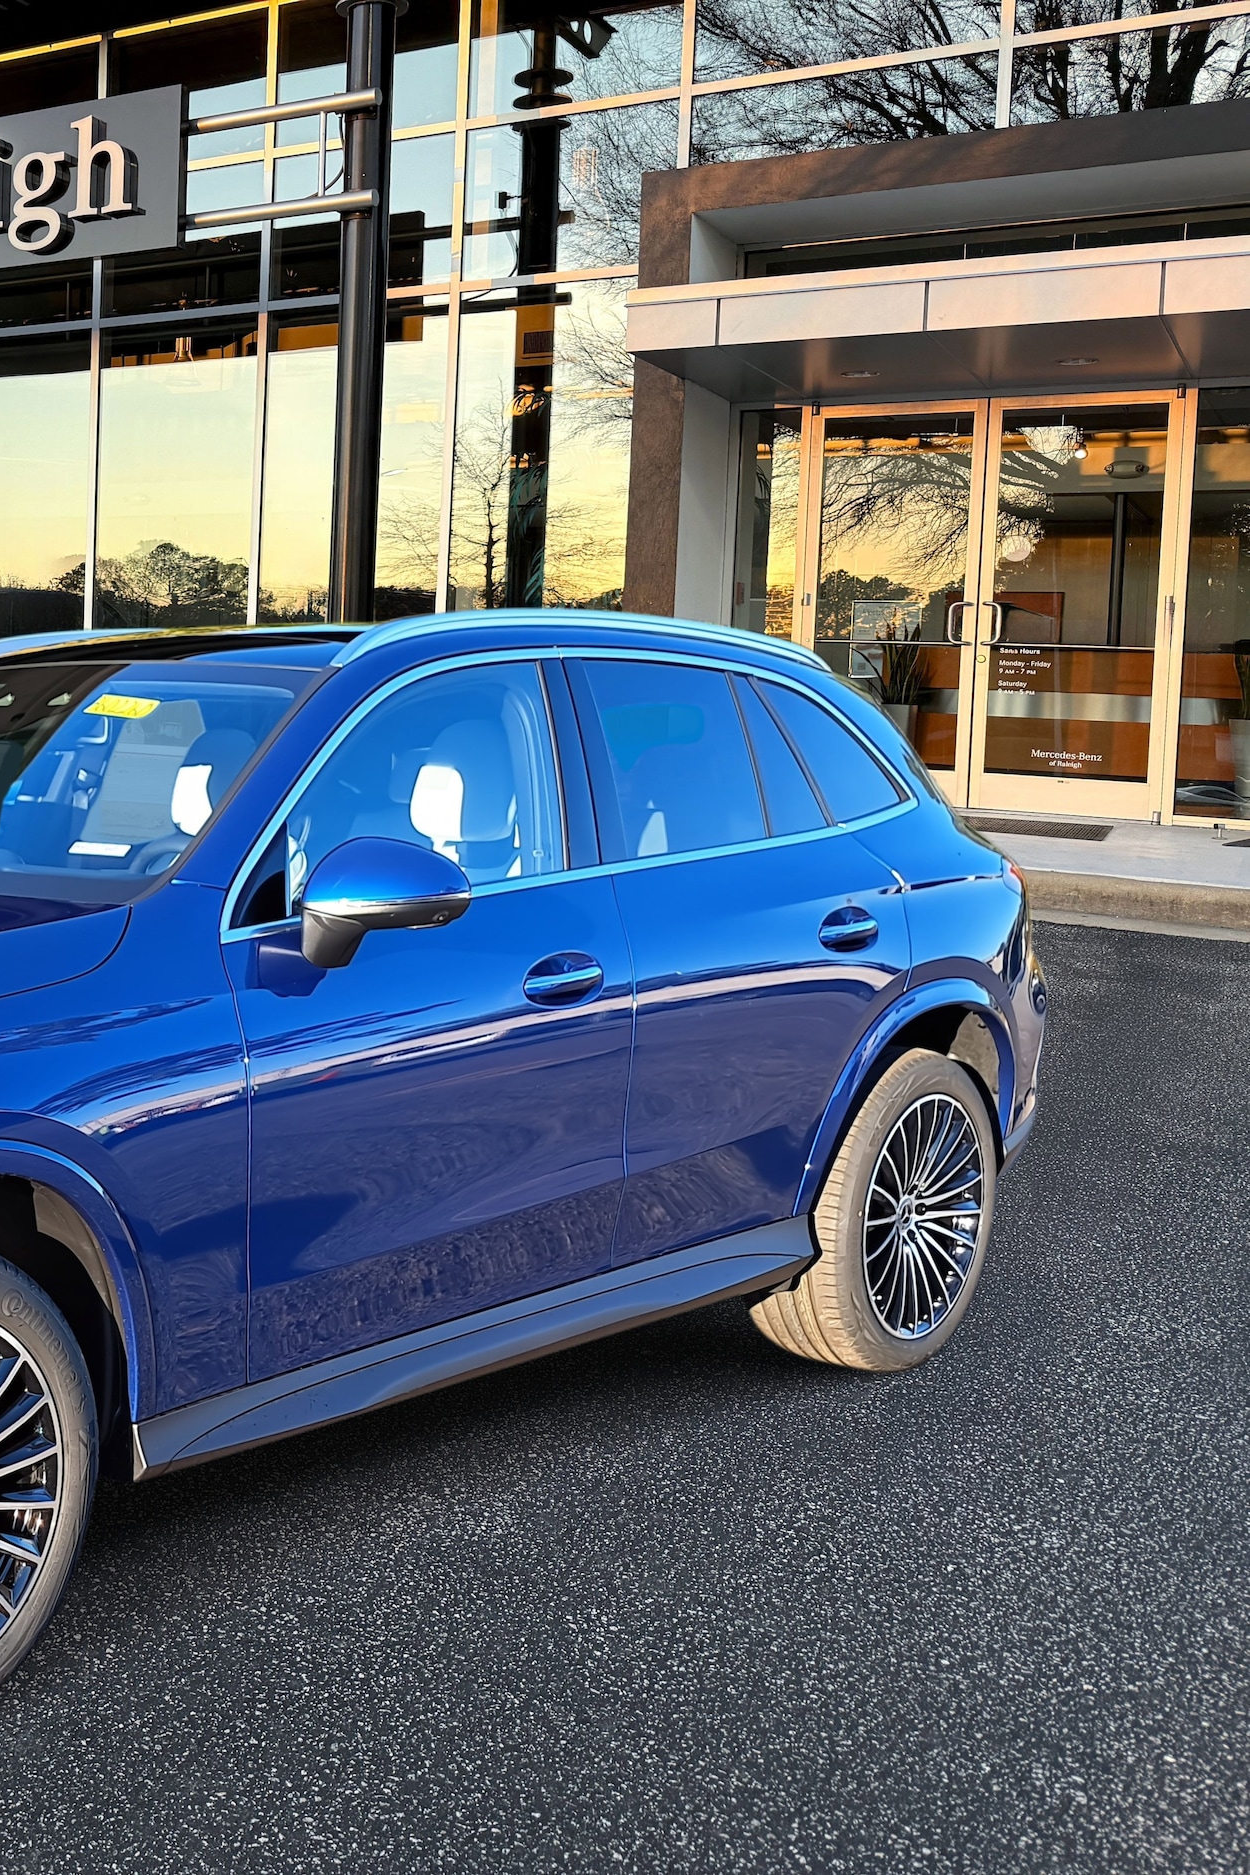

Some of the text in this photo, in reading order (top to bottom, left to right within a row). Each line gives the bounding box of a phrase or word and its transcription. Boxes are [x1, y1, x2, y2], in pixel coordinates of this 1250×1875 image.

[999, 660, 1026, 668] Monday
[1031, 661, 1051, 669] Friday
[998, 680, 1028, 688] Saturday
[1031, 749, 1103, 762] Mercedes-Benz
